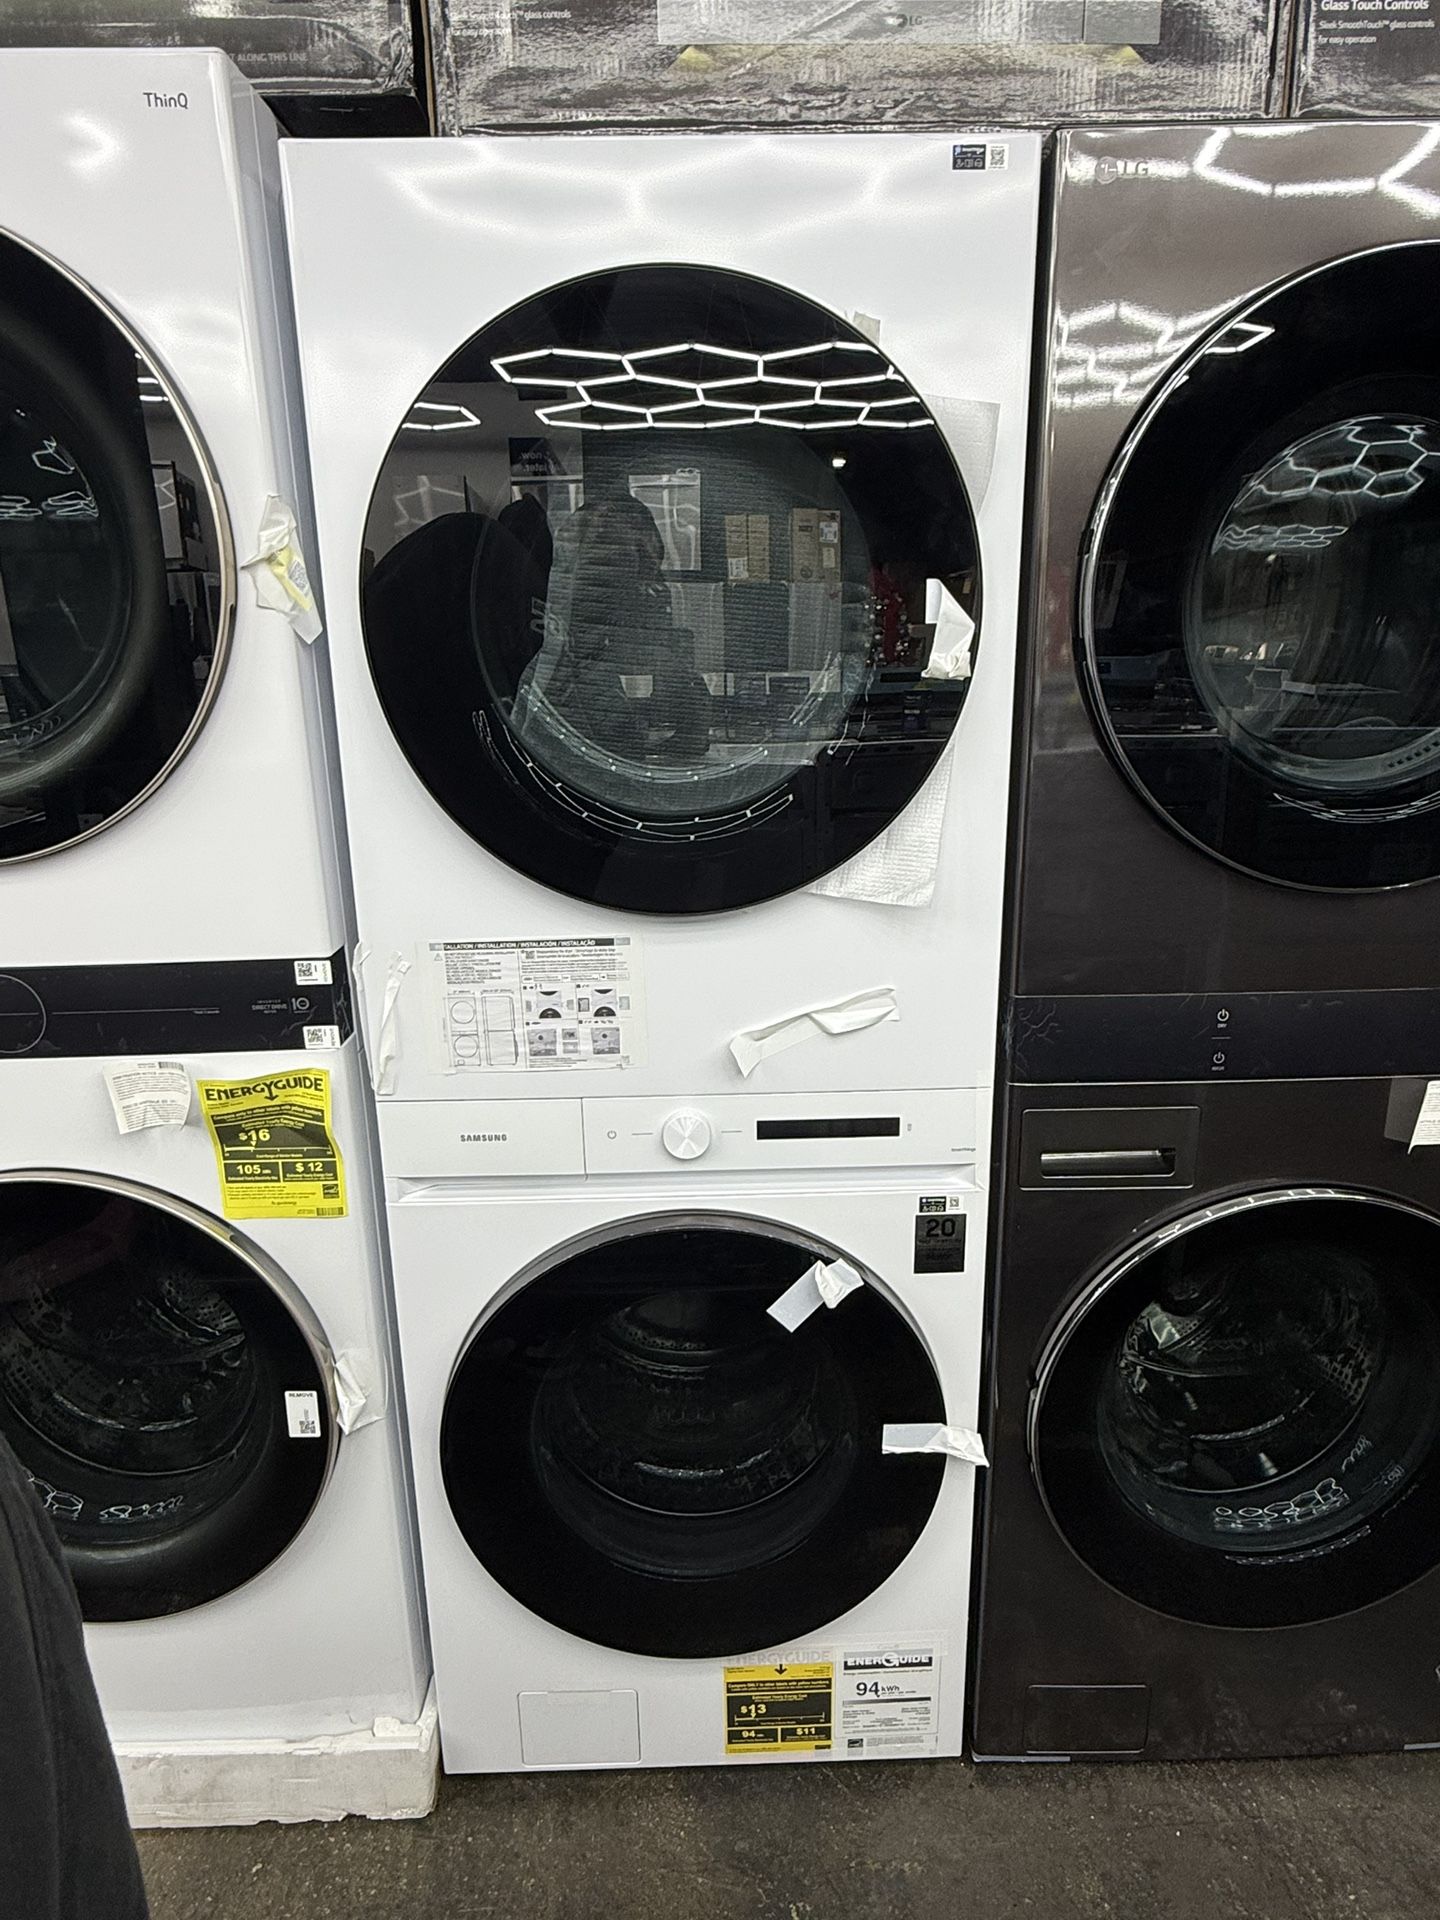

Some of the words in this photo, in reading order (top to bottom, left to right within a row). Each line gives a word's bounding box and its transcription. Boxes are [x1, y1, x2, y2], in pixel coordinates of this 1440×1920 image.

[1321, 0, 1349, 10] Glass
[1351, 0, 1383, 10] Touch
[1383, 0, 1430, 10] Controls
[542, 9, 572, 19] controls
[909, 15, 922, 26] LG
[1319, 20, 1338, 29] Sleek
[1389, 20, 1407, 31] glass
[1407, 19, 1435, 29] controls
[1345, 35, 1377, 45] operation
[237, 53, 267, 62] ALONG
[267, 52, 288, 61] THIS
[143, 92, 188, 109] ThinQ
[291, 997, 310, 1010] 10
[205, 1076, 324, 1101] ENERGYGUIDE
[238, 1129, 271, 1142] $16
[460, 1134, 507, 1142] SAMSUNG
[236, 1164, 262, 1174] 105
[295, 1162, 305, 1173] $
[308, 1161, 323, 1172] 12
[926, 1217, 956, 1237] 20
[847, 1652, 930, 1667] ENERGUIDE
[856, 1681, 880, 1697] 94
[740, 1703, 767, 1715] $13
[741, 1730, 756, 1738] 94
[796, 1727, 816, 1735] $11
